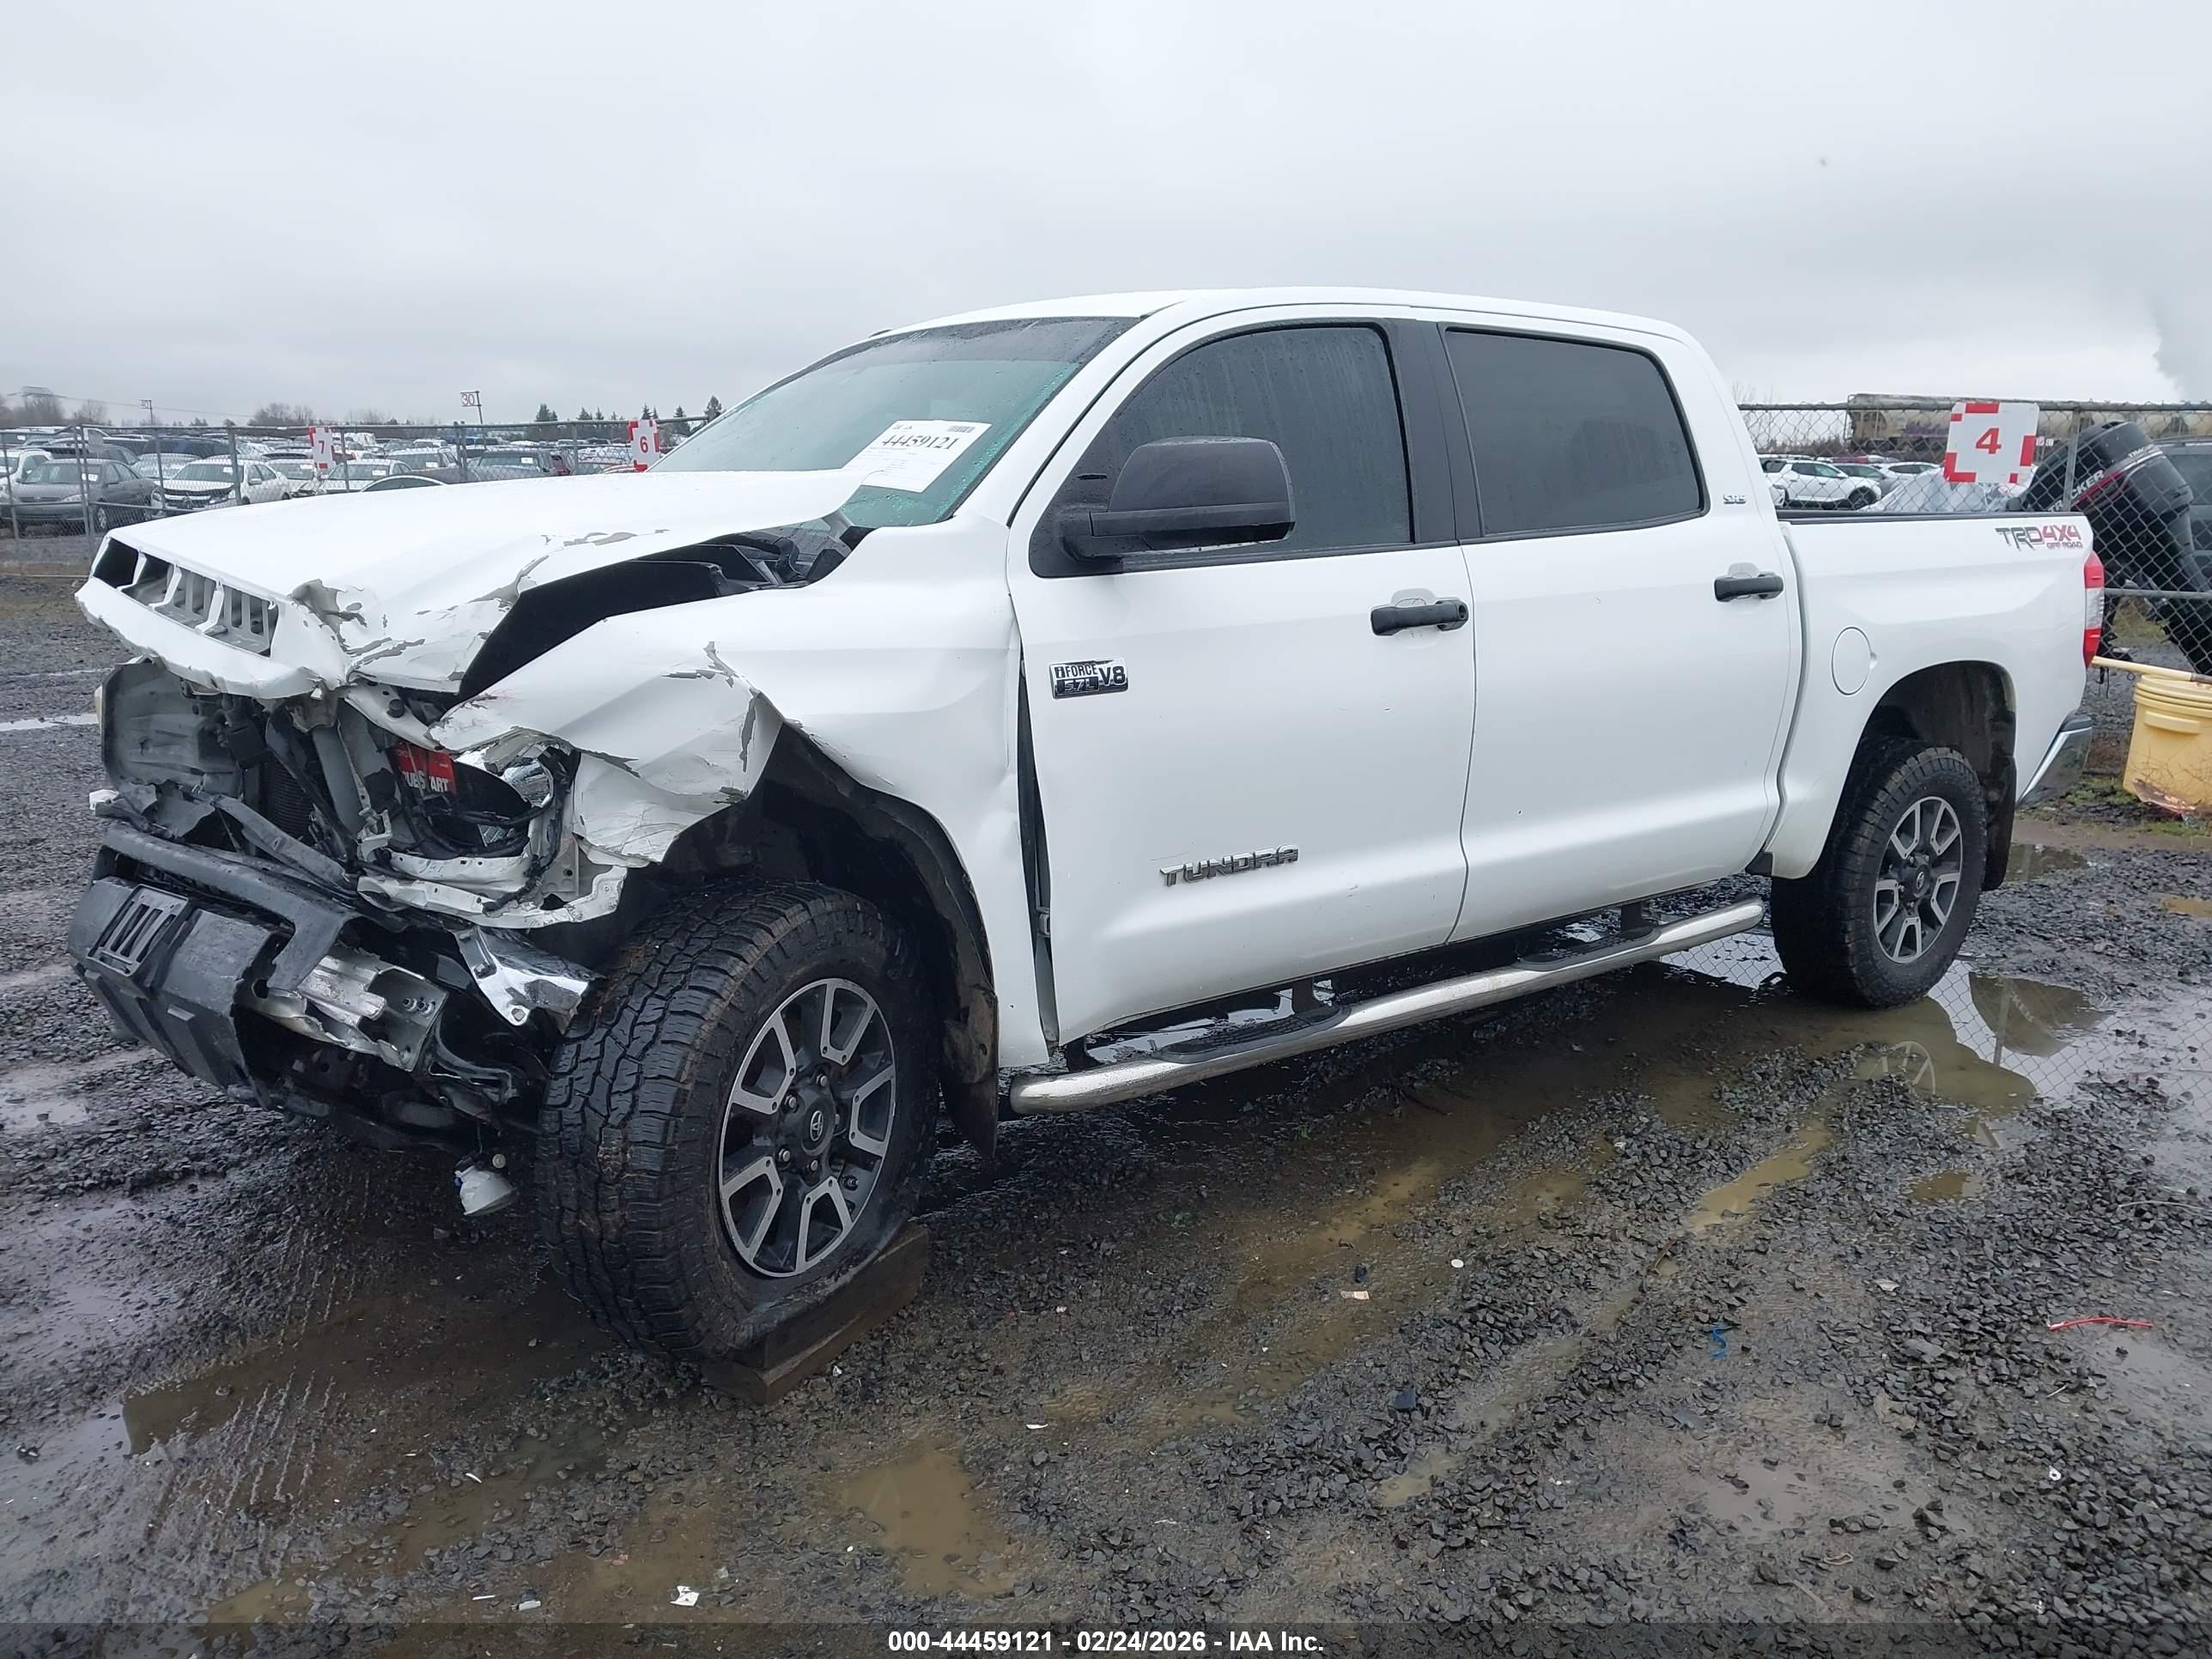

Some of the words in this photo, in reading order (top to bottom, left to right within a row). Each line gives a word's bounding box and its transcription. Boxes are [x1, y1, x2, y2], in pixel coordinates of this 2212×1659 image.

[461, 393, 475, 405] 30
[319, 440, 325, 454] 7
[640, 435, 648, 453] 6
[881, 434, 960, 450] 44459121
[1975, 428, 2002, 454] 4
[2047, 469, 2106, 513] TRCKER
[1995, 526, 2045, 550] TRD
[1098, 665, 1127, 686] V8
[1160, 844, 1299, 886] TUNDRA
